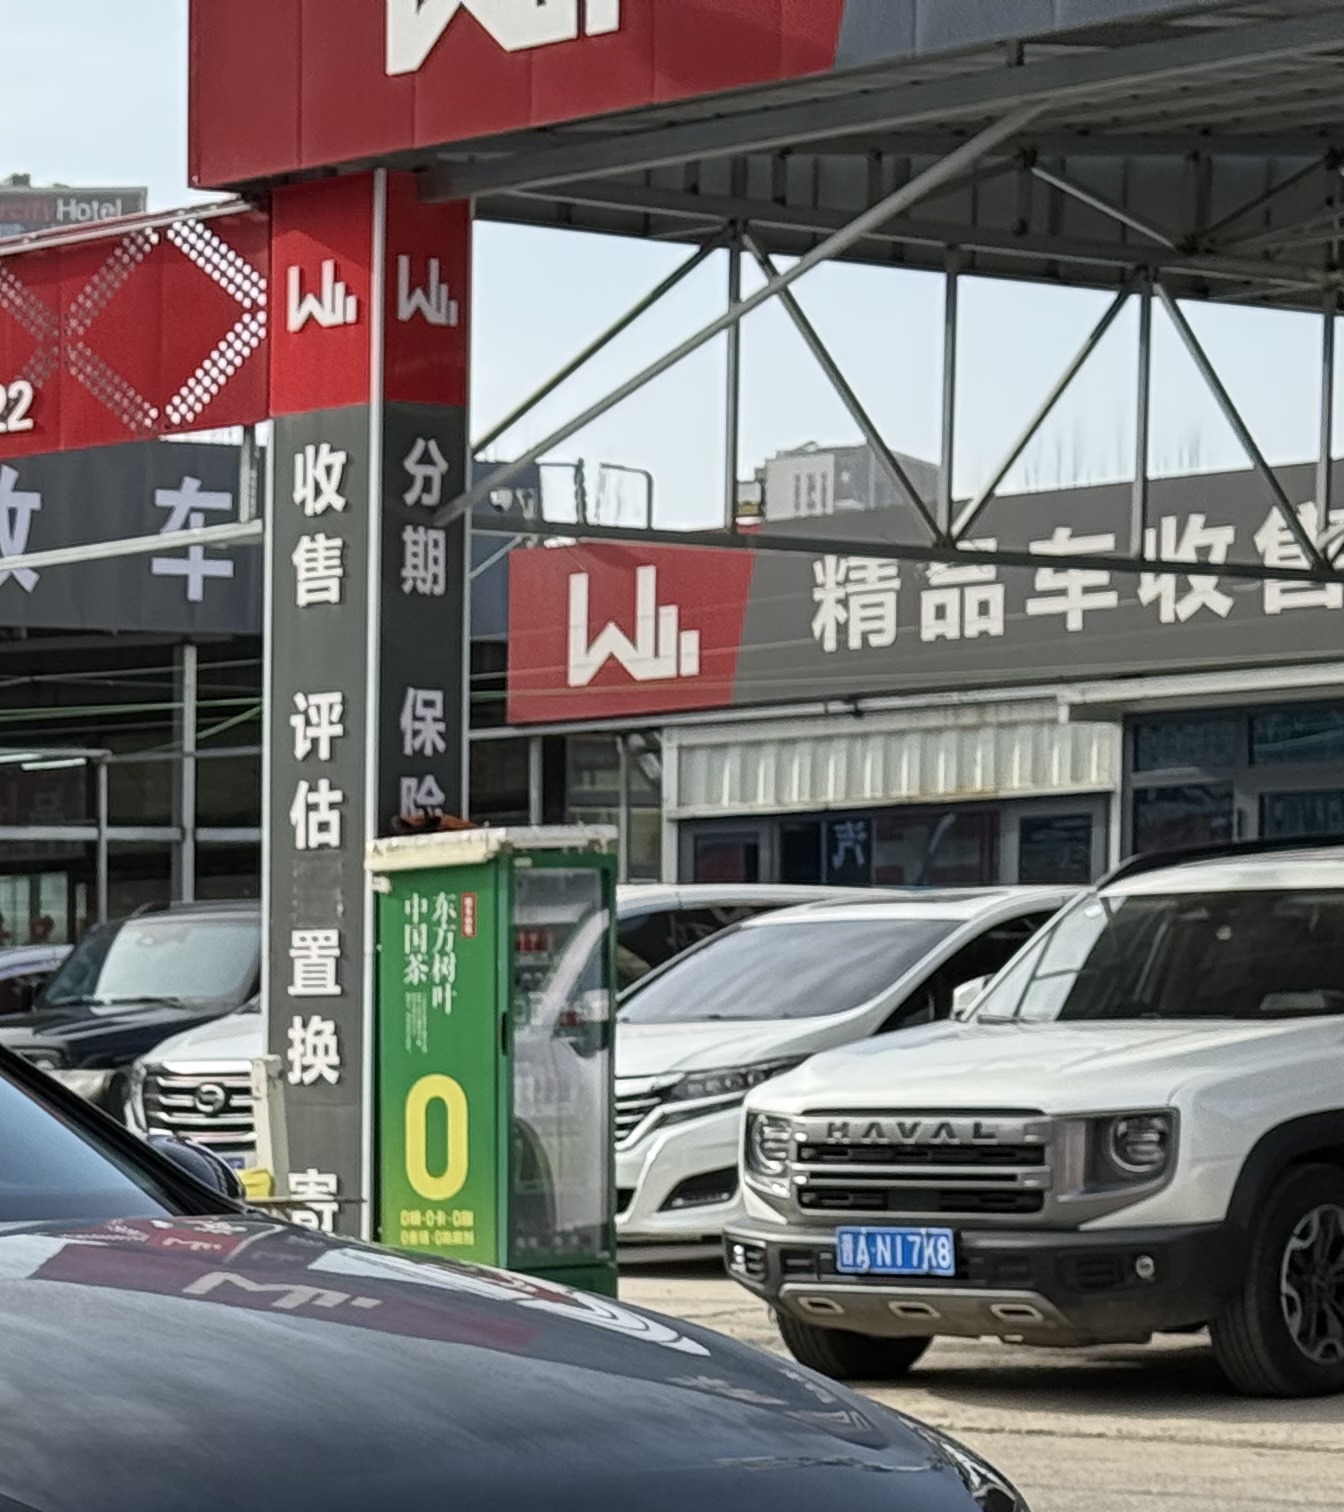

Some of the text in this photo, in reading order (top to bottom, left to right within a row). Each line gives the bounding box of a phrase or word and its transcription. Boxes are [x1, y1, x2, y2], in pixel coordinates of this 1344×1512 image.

[55, 198, 123, 223] Hotel
[405, 1073, 469, 1201] 0
[826, 1121, 999, 1145] HAVAL
